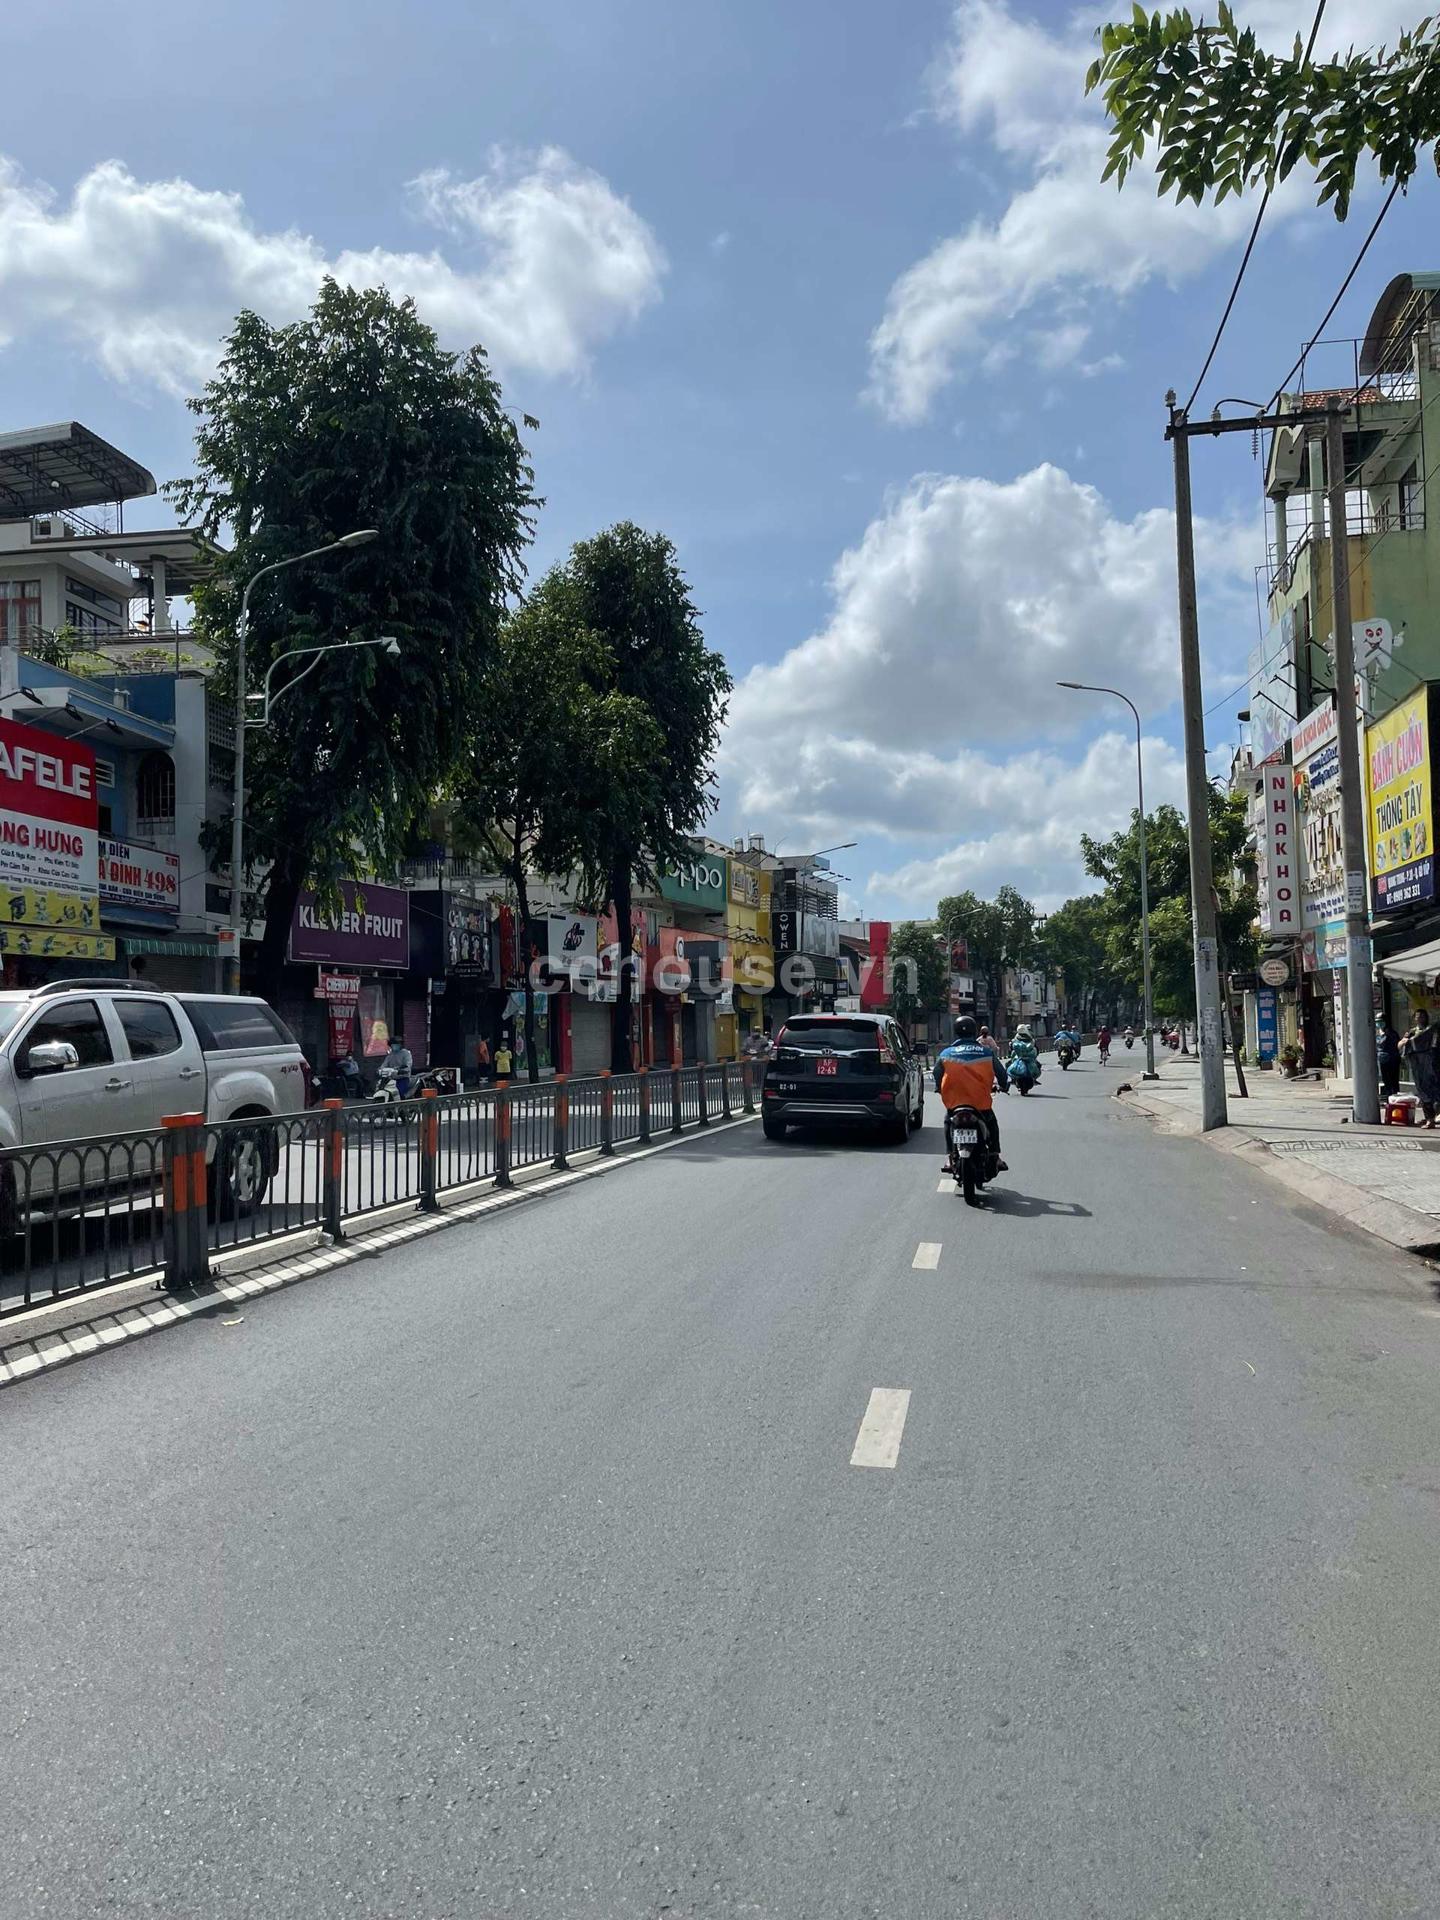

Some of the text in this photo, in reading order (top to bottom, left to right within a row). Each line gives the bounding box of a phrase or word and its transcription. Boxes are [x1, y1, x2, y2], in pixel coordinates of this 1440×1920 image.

[1376, 794, 1402, 835] THÔNG
[1404, 780, 1422, 820] TÂY
[0, 821, 84, 857] NG HƯNG
[144, 868, 177, 894] 498
[364, 914, 404, 939] FRUIT
[780, 913, 790, 950] OWEN
